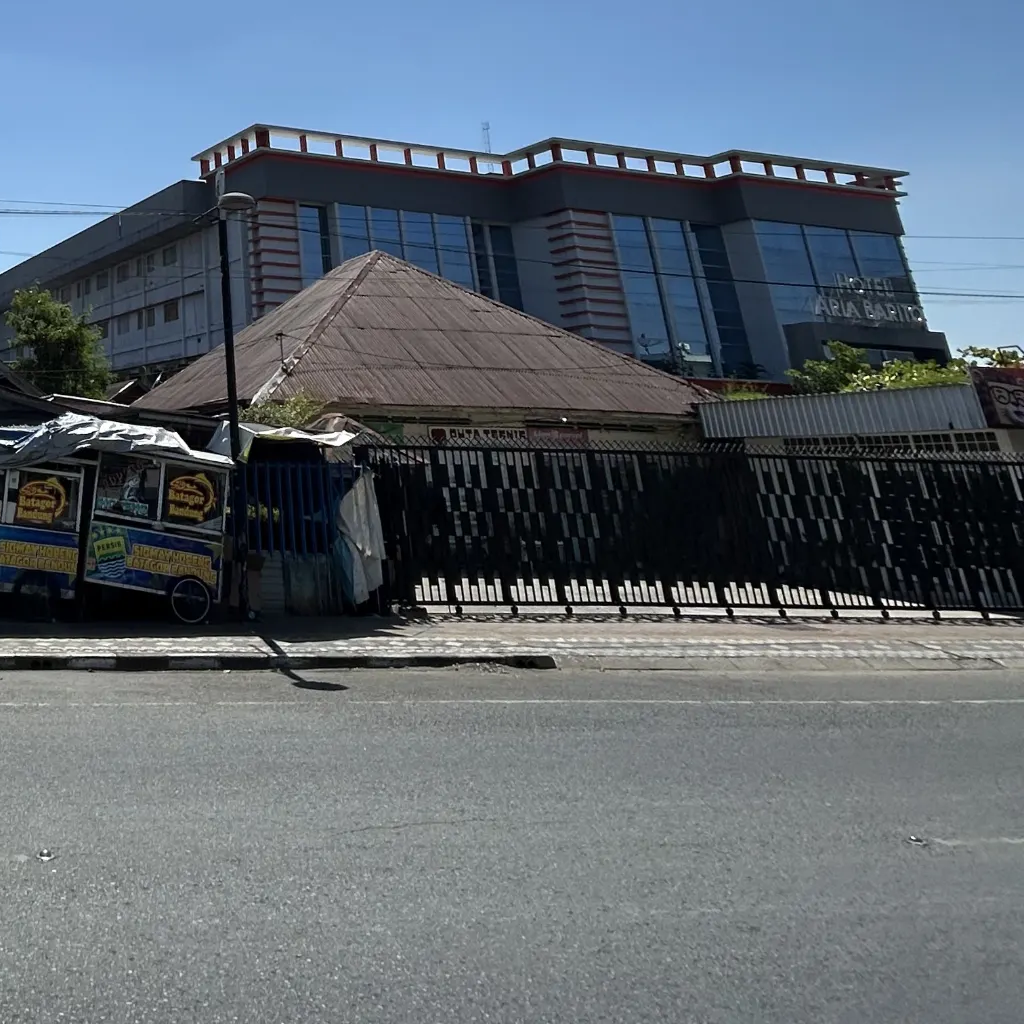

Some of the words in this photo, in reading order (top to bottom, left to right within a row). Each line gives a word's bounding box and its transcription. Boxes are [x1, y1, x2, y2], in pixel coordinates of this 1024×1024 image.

[834, 272, 895, 297] HOTEL
[18, 495, 56, 509] Batagor
[168, 488, 206, 505] Batagor
[97, 541, 122, 552] PERSIB
